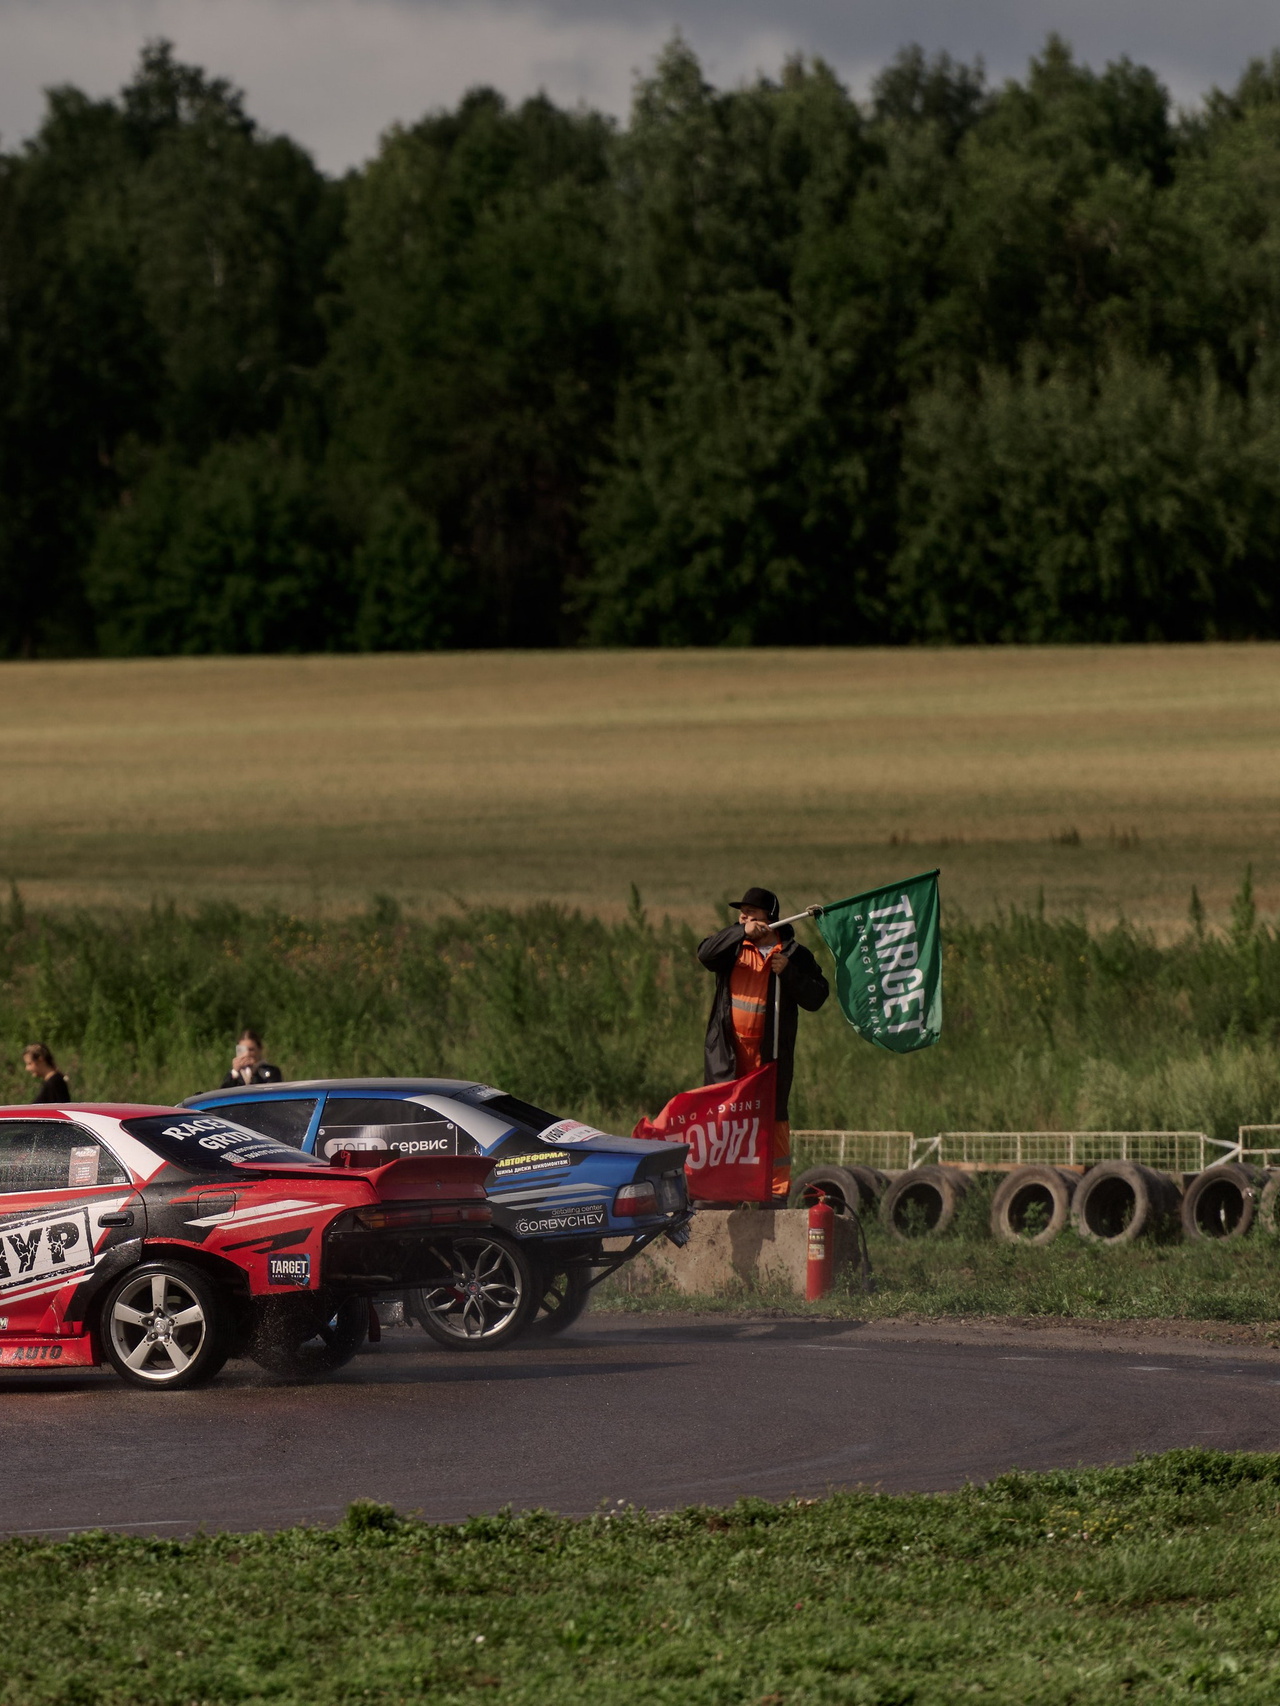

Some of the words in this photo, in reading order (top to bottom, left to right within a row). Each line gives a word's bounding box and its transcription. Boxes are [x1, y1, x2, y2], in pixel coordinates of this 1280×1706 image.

[869, 894, 927, 1034] TARGET
[854, 914, 875, 975] ENERGY
[867, 984, 882, 1035] DRINK
[706, 1100, 760, 1116] ENERGY
[670, 1112, 697, 1126] DRI
[162, 1118, 227, 1141] RACE
[198, 1131, 253, 1150] GRID
[390, 1139, 448, 1154] сервис
[663, 1117, 760, 1170] TARG
[551, 1207, 580, 1215] detailing
[581, 1204, 603, 1212] center
[270, 1260, 307, 1274] TARGET
[11, 1345, 63, 1360] AUTO
